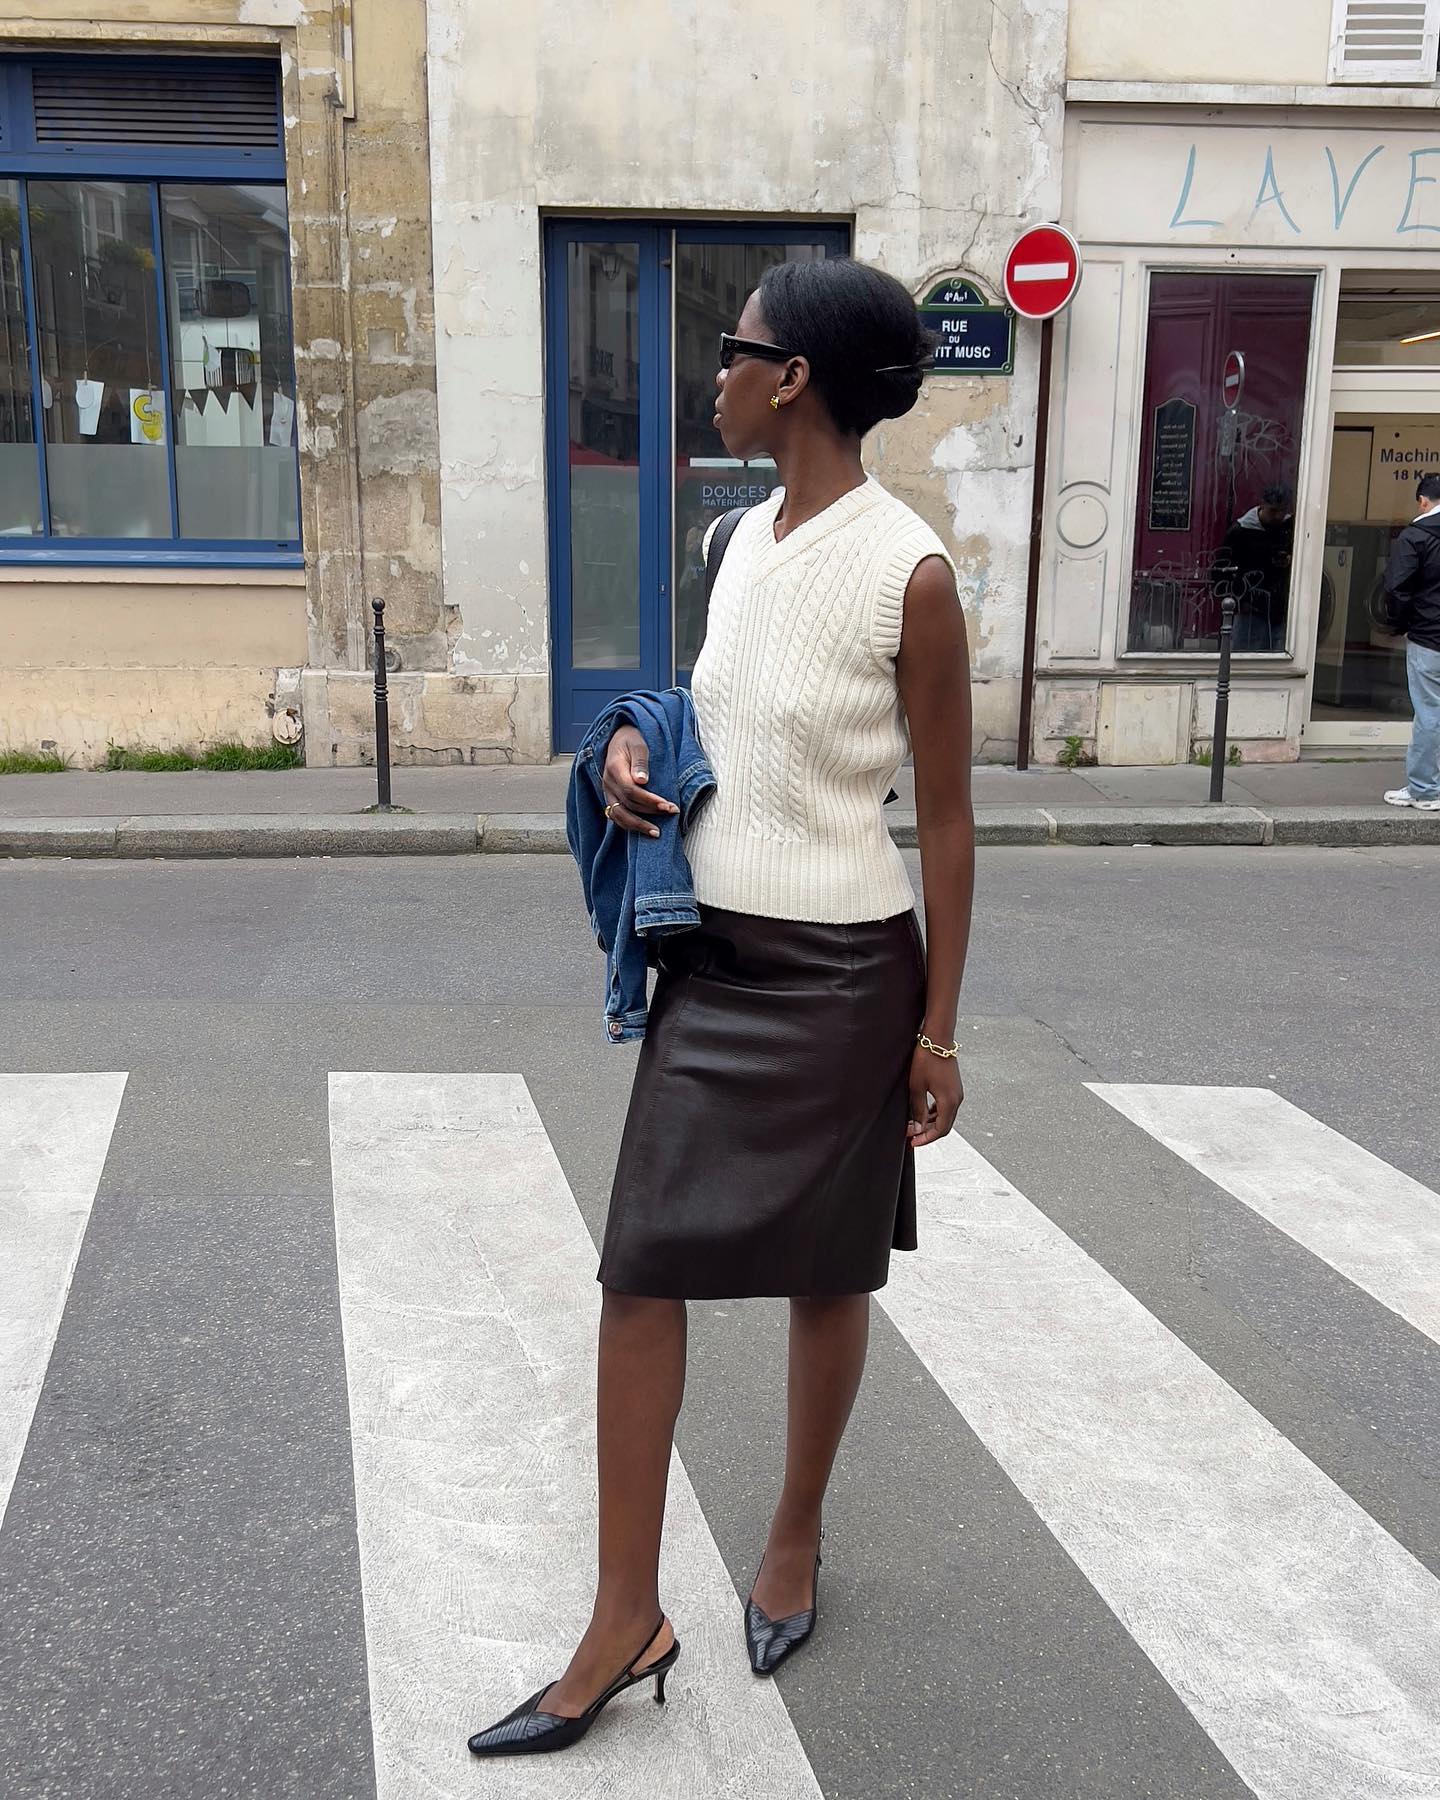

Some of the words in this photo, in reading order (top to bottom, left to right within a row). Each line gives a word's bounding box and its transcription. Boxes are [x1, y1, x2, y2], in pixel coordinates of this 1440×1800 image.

[942, 320, 968, 333] RUE
[948, 335, 960, 344] DU
[935, 346, 952, 359] TIT
[955, 346, 991, 359] MUSC
[1380, 447, 1440, 463] Machin
[1392, 469, 1409, 481] 18
[702, 485, 767, 498] DOUCES
[702, 498, 765, 507] MATERNELLE
